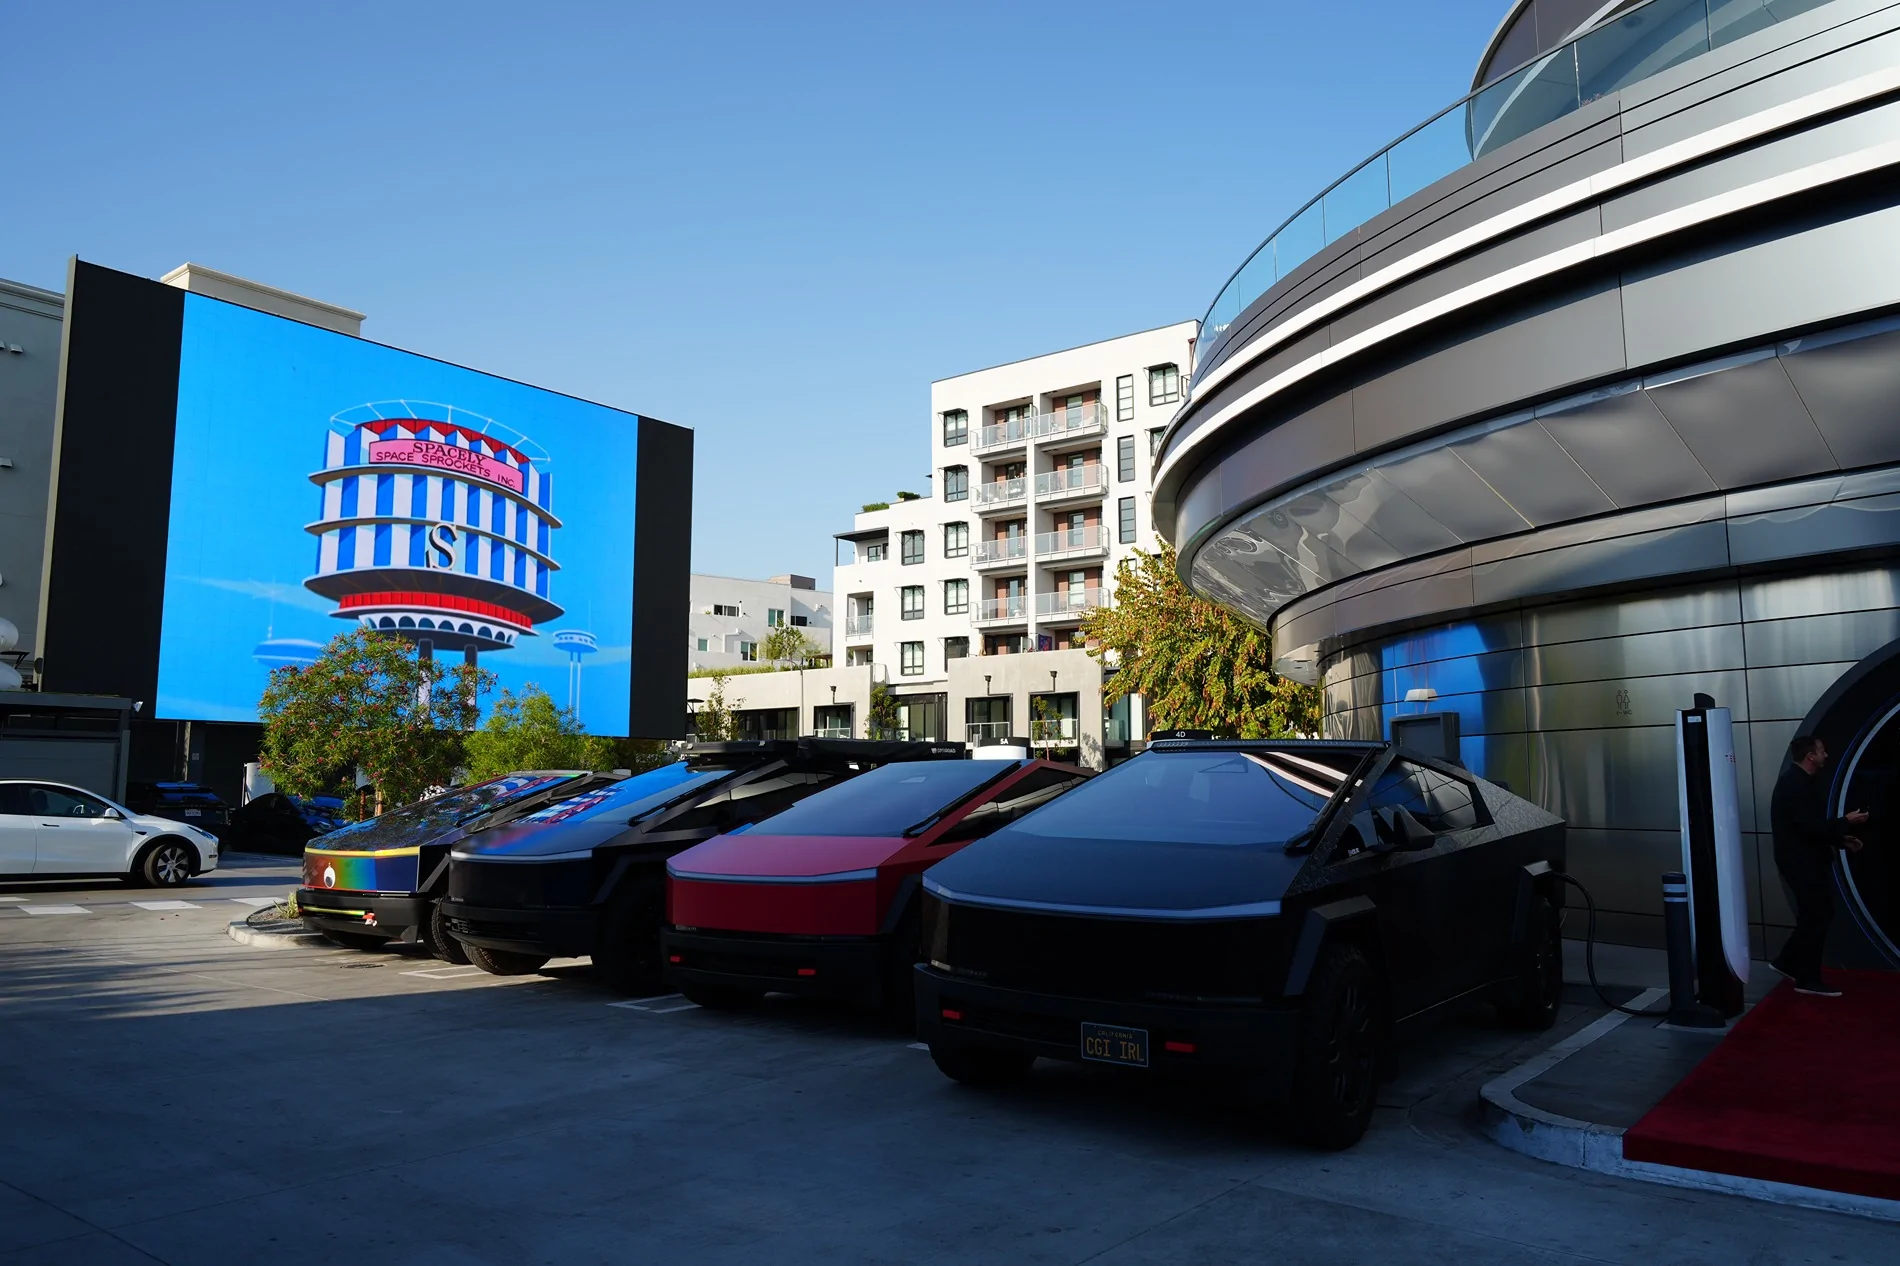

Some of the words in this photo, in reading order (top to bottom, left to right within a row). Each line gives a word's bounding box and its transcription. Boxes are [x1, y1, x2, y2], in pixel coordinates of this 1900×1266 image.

[413, 442, 487, 466] SPACELY
[376, 451, 414, 462] SPACE
[421, 454, 491, 477] SPROCKETS
[497, 474, 516, 488] INC.
[426, 523, 458, 571] S
[1097, 1030, 1133, 1039] CALIFORNIA
[1086, 1037, 1111, 1057] CGI
[1119, 1041, 1145, 1061] IRL
